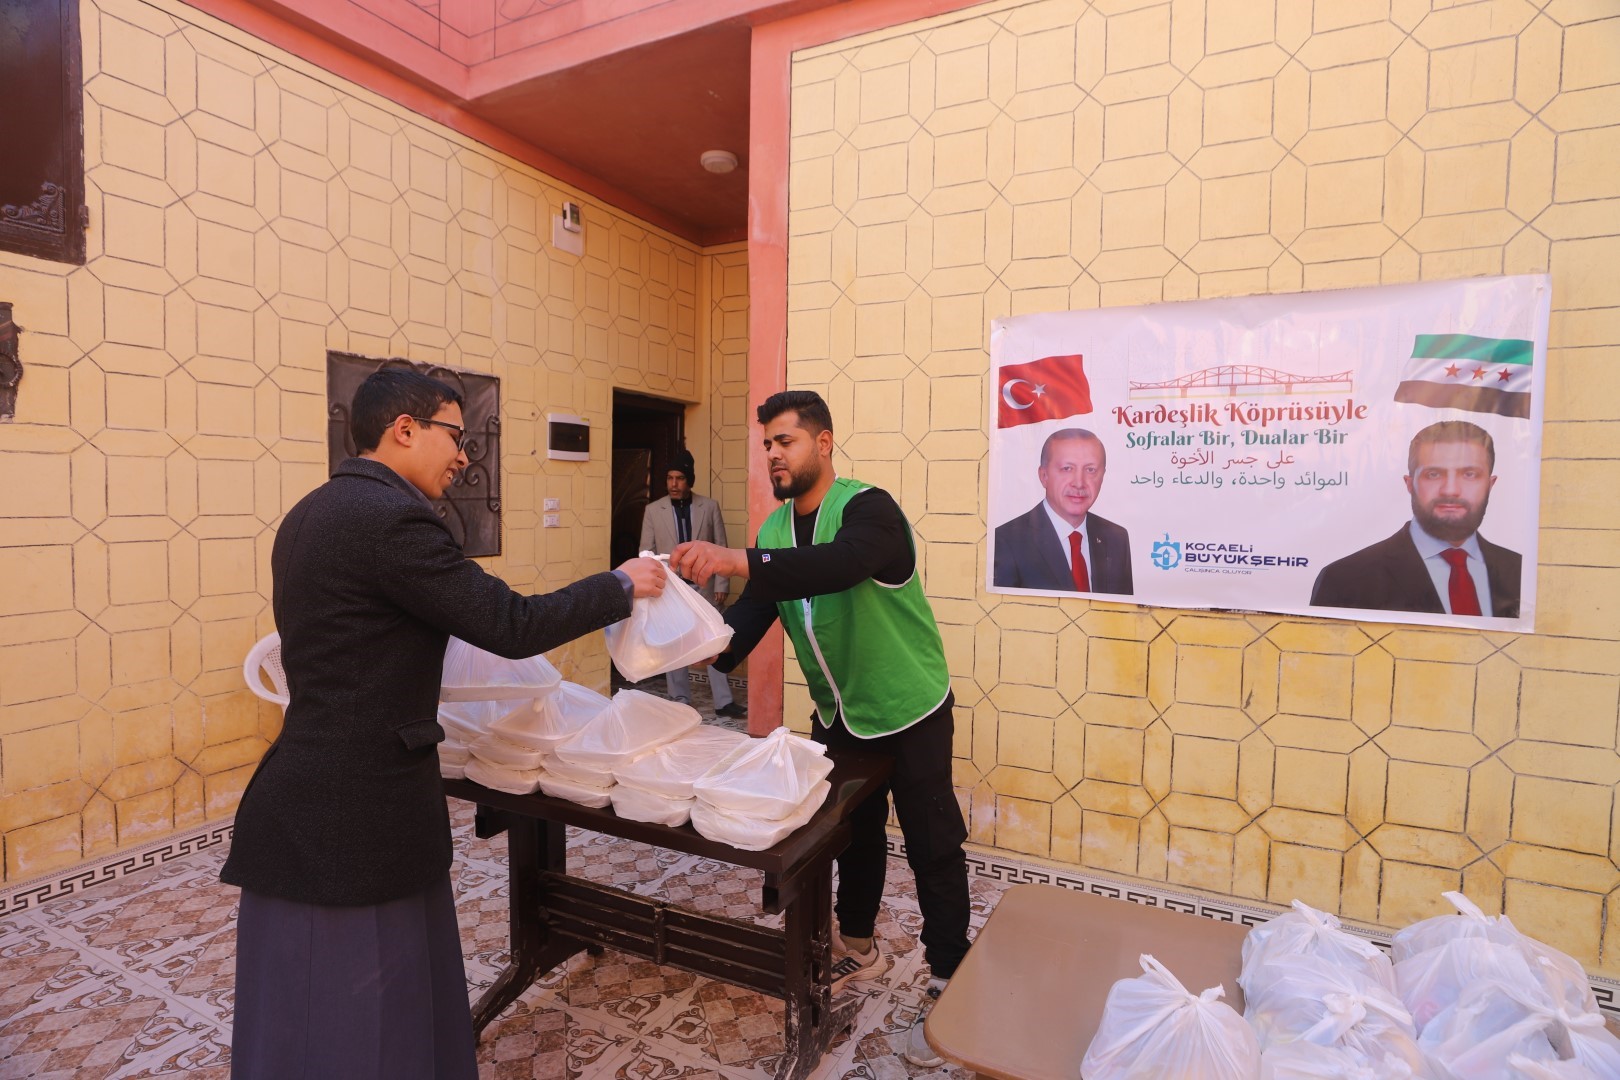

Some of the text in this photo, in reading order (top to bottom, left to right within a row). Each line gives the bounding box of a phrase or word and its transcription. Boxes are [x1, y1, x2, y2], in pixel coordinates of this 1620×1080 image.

[1111, 398, 1368, 429] Kardeşlik Köprüsüyle
[1126, 428, 1349, 450] Sofralar Bir, Dualar Bir
[1170, 448, 1295, 470] على جسر الأخوة
[1130, 470, 1348, 490] الموائد واحدة، والدعاء واحد
